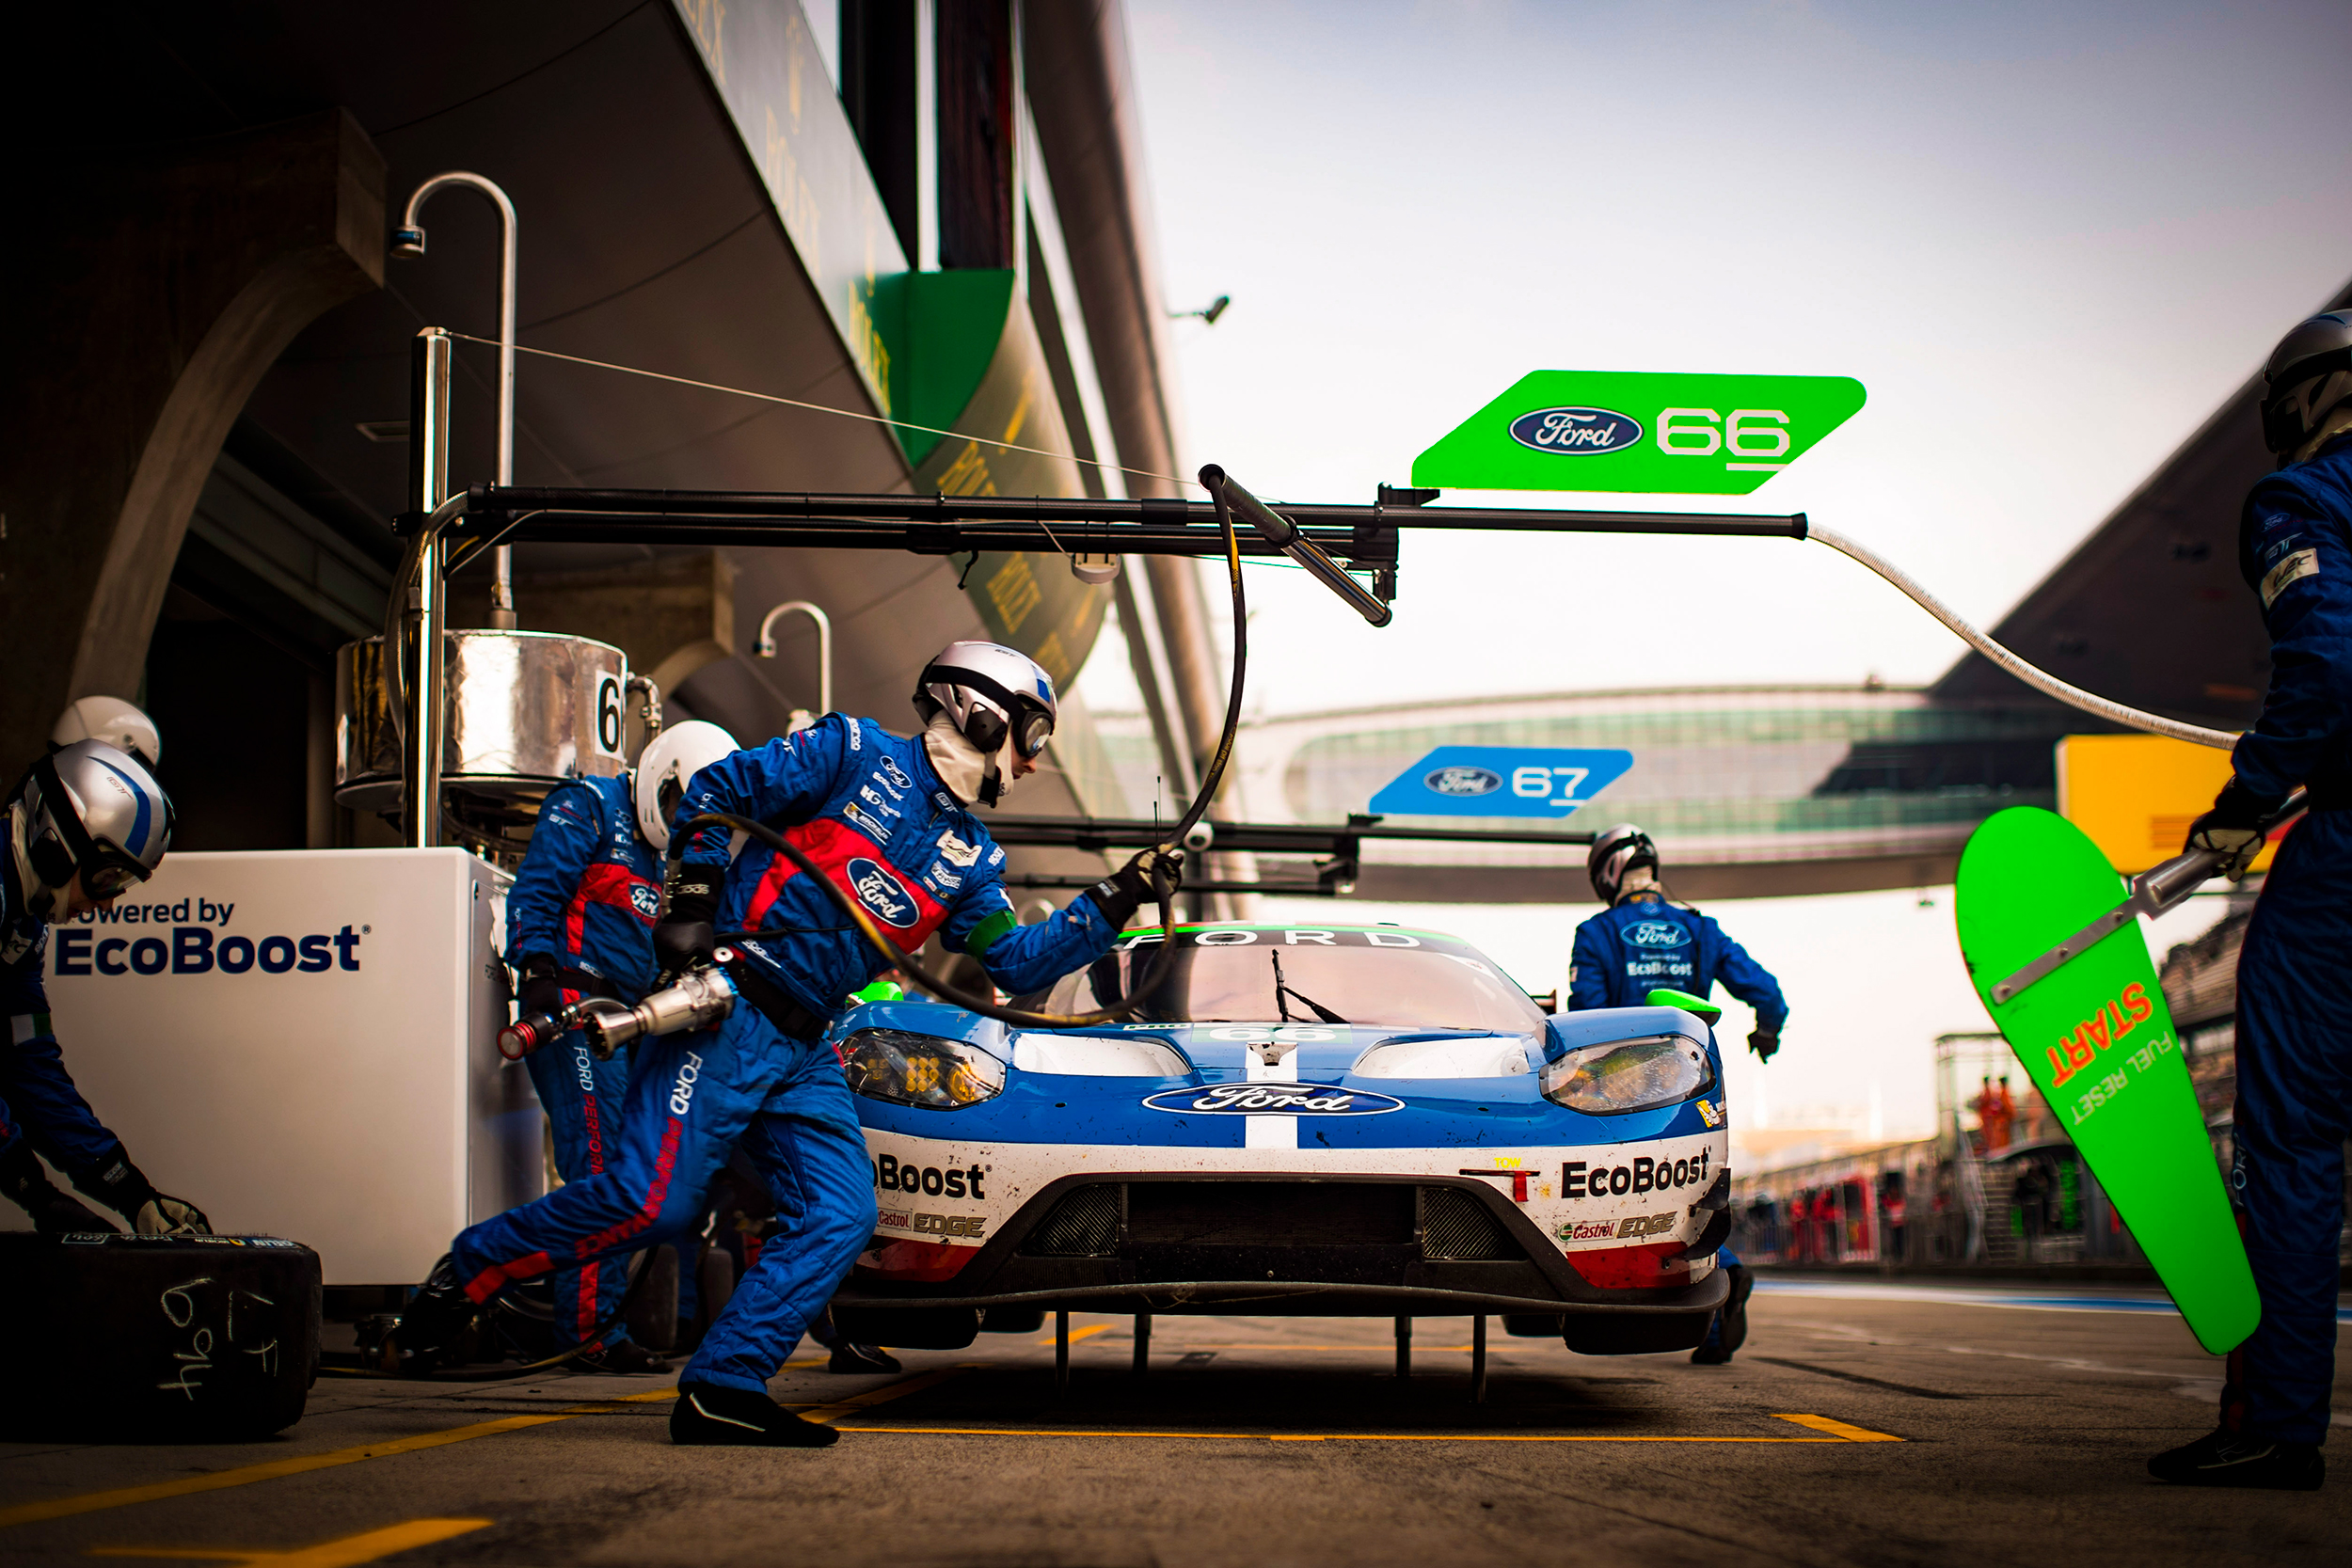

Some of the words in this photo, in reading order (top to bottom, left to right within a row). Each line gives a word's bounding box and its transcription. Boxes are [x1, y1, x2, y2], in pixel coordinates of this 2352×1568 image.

[1535, 412, 1618, 447] Ford
[1657, 407, 1790, 456] 66
[598, 678, 624, 752] 6
[1438, 768, 1486, 793] Ford
[1513, 767, 1589, 799] 67
[78, 897, 190, 925] owered
[199, 897, 234, 927] by
[858, 870, 906, 918] Ford
[55, 925, 360, 976] EcoBoost
[1635, 922, 1681, 944] Ford
[1209, 1027, 1337, 1041] 66
[2045, 981, 2153, 1088] START
[2126, 1031, 2173, 1073] FUEL
[573, 1046, 594, 1092] FORD
[670, 1051, 704, 1116] FORD
[1193, 1085, 1355, 1112] Ford
[2071, 1067, 2129, 1126] RESET
[582, 1093, 605, 1176] PERFORM
[872, 1153, 986, 1200] Boost
[1494, 1157, 1522, 1168] TOW
[1561, 1147, 1709, 1199] EcoBoost
[879, 1210, 910, 1228] Castrol
[913, 1212, 988, 1238] EDGE
[1573, 1223, 1615, 1241] Castrol
[1616, 1212, 1678, 1240] EDGE
